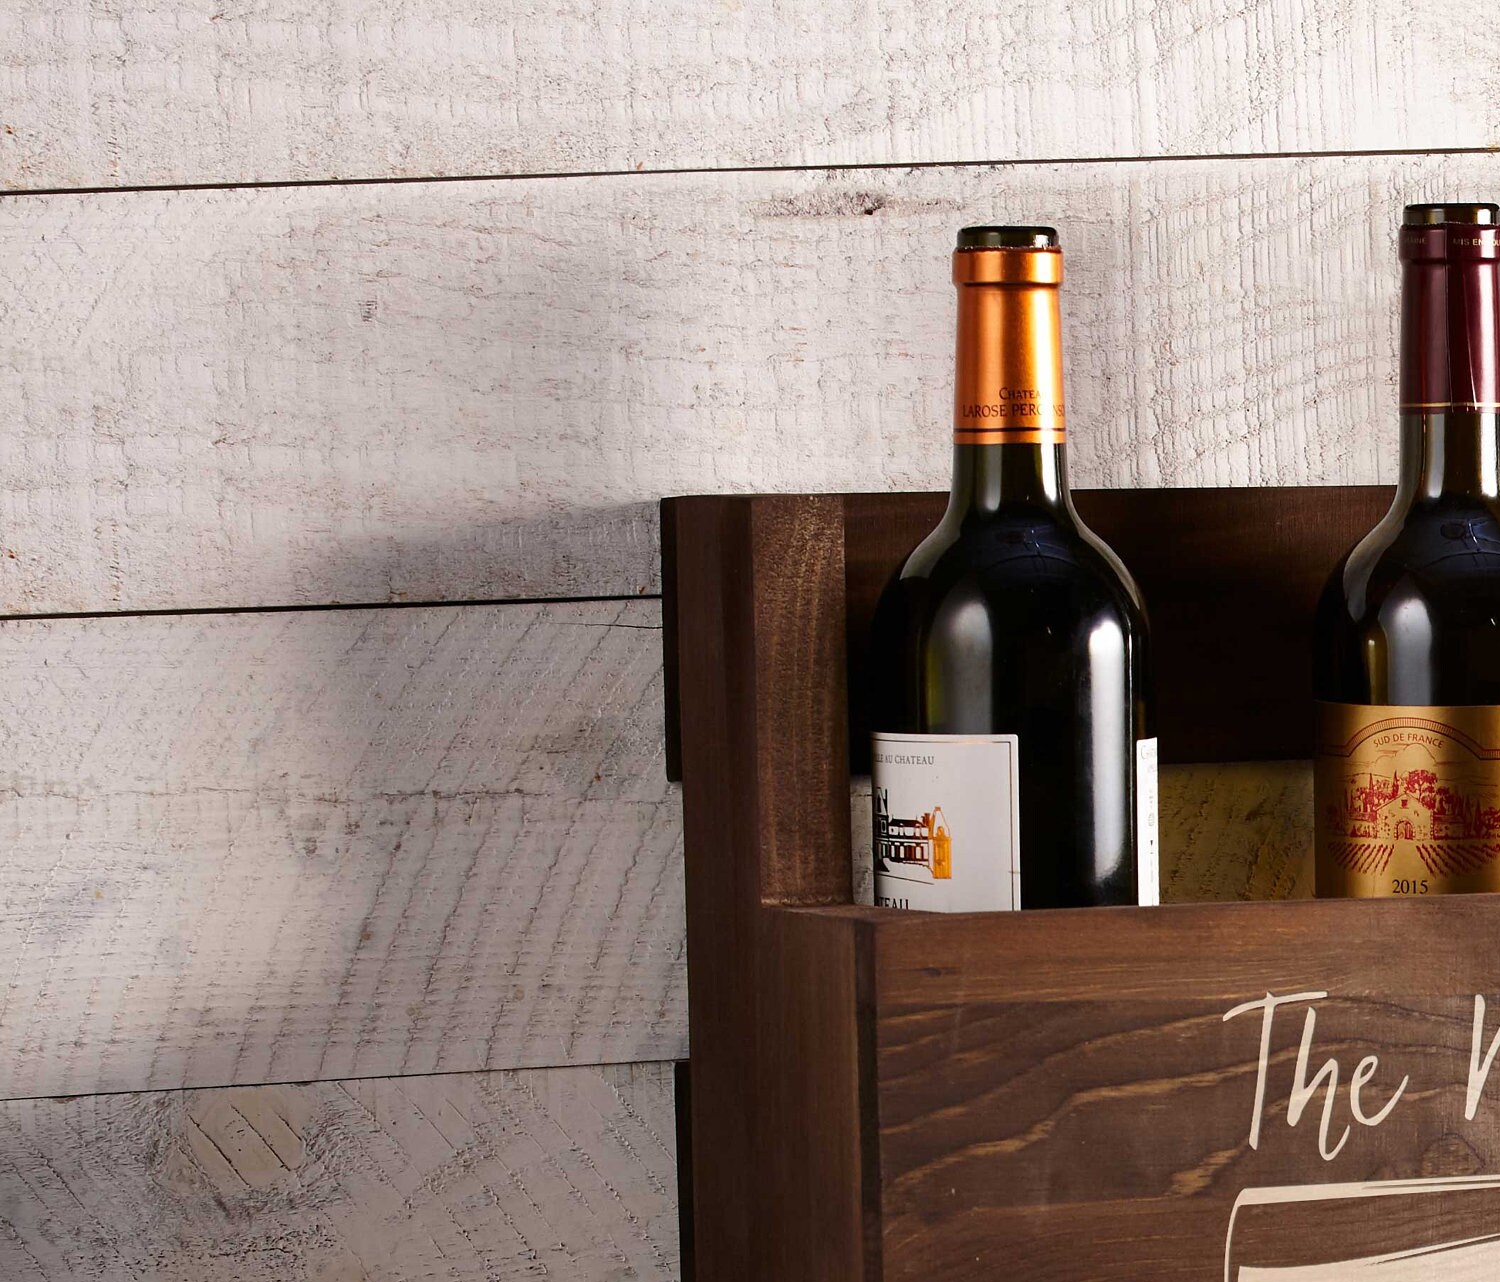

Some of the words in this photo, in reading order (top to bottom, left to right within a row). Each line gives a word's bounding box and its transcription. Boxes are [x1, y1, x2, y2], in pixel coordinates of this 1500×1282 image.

[962, 404, 1008, 418] LAROSE
[1373, 735, 1391, 748] SUD
[1392, 733, 1405, 742] DE
[1407, 733, 1445, 749] FRANCE
[894, 754, 935, 766] CHATEAU
[1391, 879, 1429, 895] 2015
[1223, 991, 1409, 1161] The
